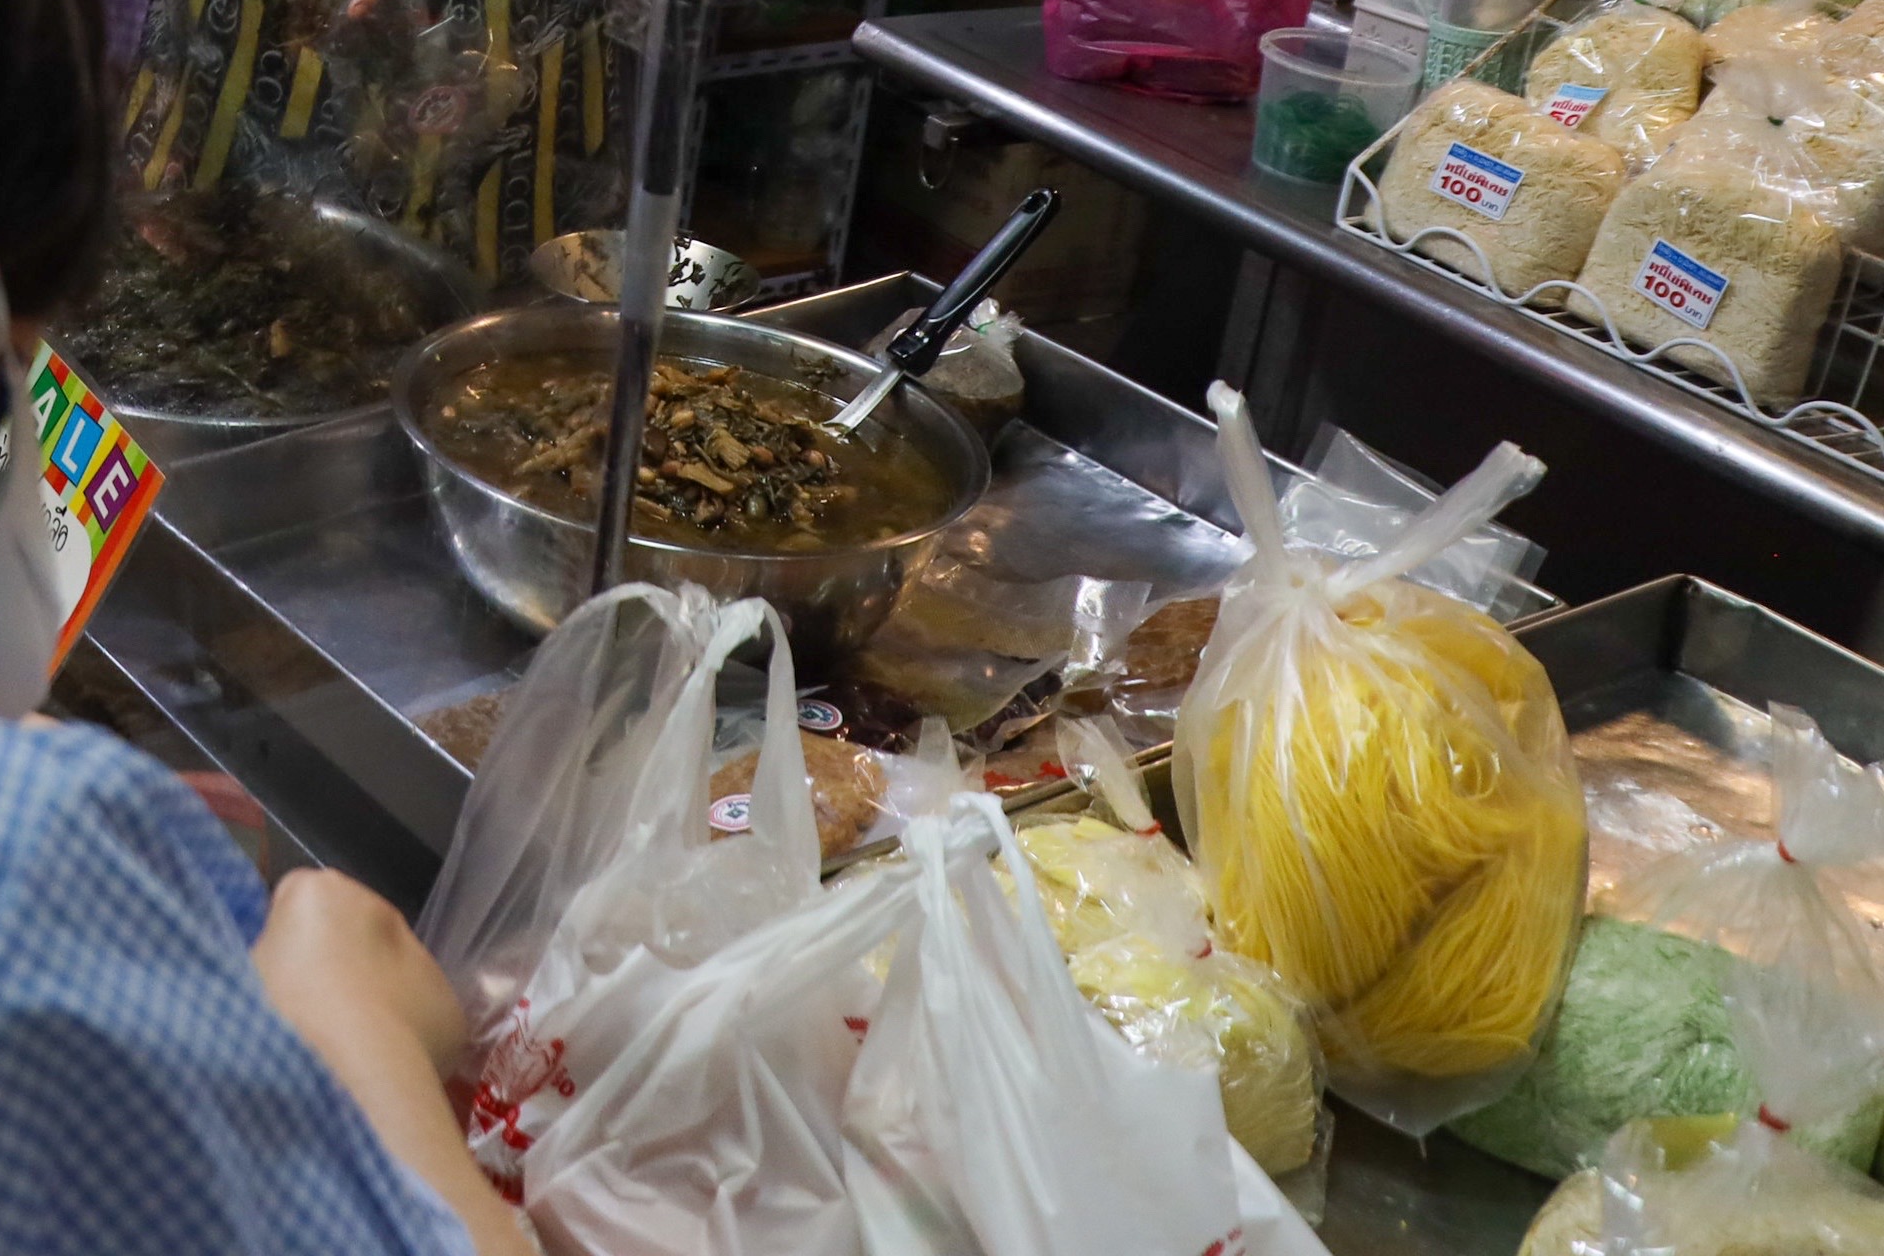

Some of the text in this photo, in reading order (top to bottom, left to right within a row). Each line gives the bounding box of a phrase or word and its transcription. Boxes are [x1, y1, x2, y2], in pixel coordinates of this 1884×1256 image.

[1441, 175, 1500, 212] 100 บาท
[1644, 275, 1703, 321] 100 บาท
[31, 386, 130, 520] ALE
